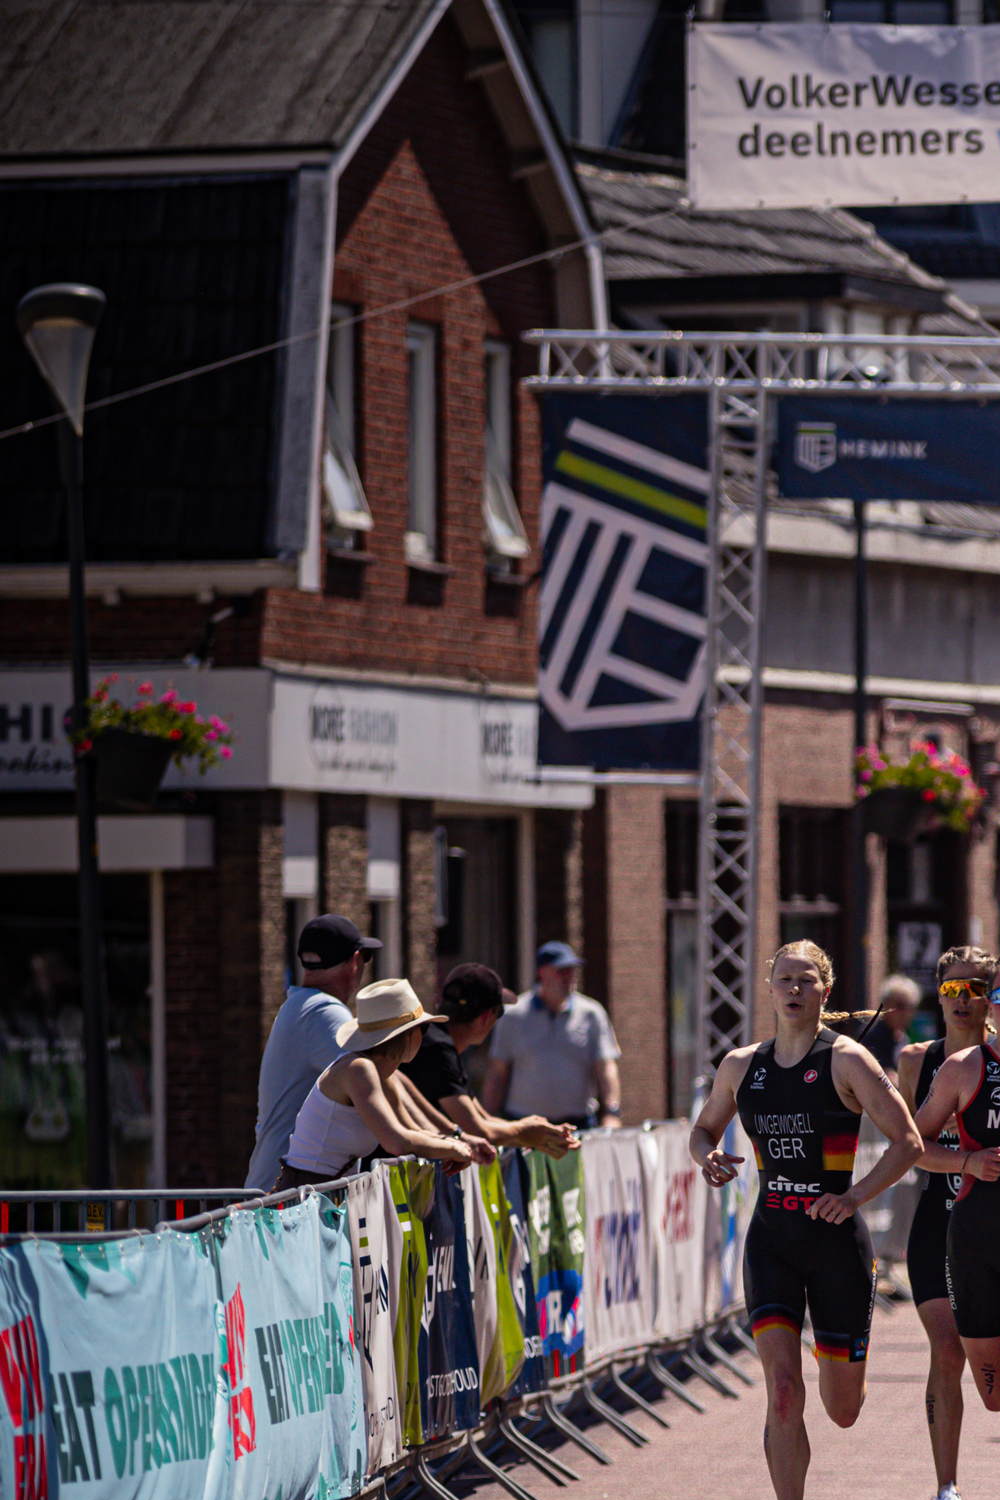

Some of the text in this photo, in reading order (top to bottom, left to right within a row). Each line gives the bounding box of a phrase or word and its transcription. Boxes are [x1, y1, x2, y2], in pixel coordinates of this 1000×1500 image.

[737, 121, 985, 158] deelnemers
[840, 440, 929, 460] HEMINK
[754, 1113, 814, 1134] UNGEWICKELL
[768, 1138, 806, 1159] GER
